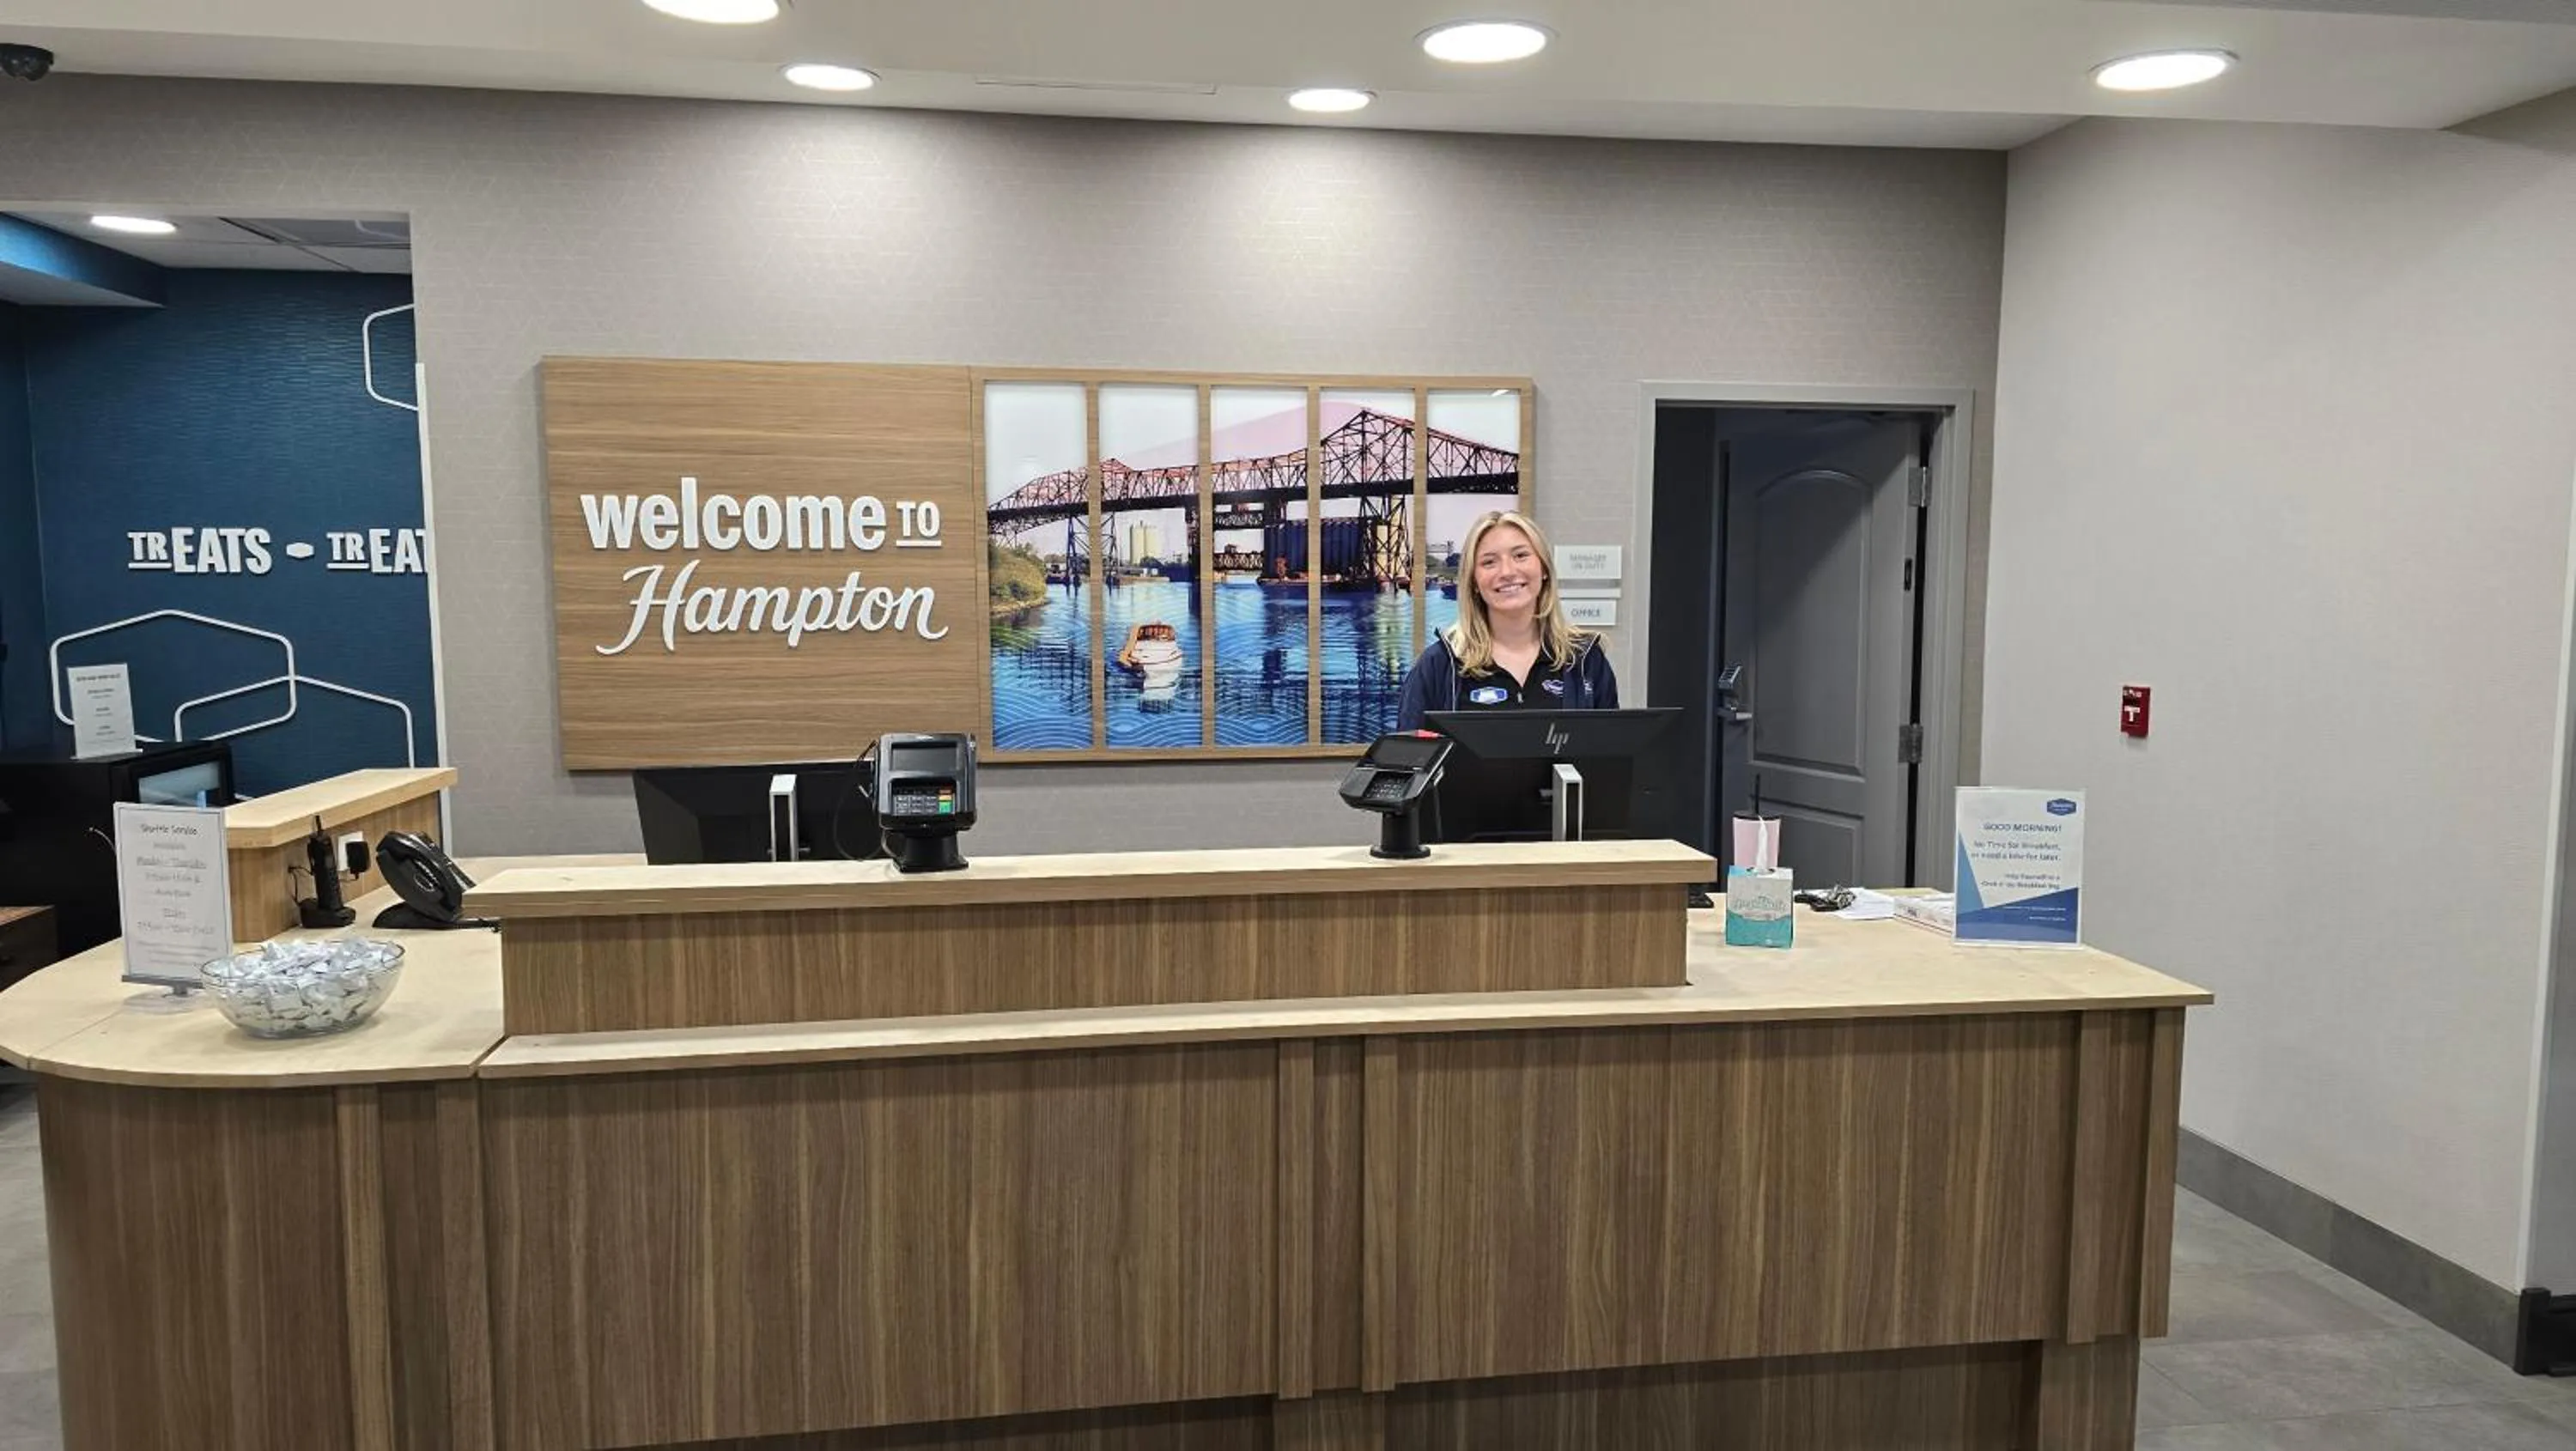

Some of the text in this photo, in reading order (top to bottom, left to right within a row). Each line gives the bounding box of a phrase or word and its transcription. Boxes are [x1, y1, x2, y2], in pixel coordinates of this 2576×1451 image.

[580, 477, 942, 550] welcome TO
[127, 527, 273, 574] TREATS
[595, 559, 949, 655] Hampton
[1571, 608, 1601, 617] OFFICE
[1546, 723, 1569, 755] hp
[171, 825, 197, 835] Service
[1984, 823, 2011, 831] GOOD
